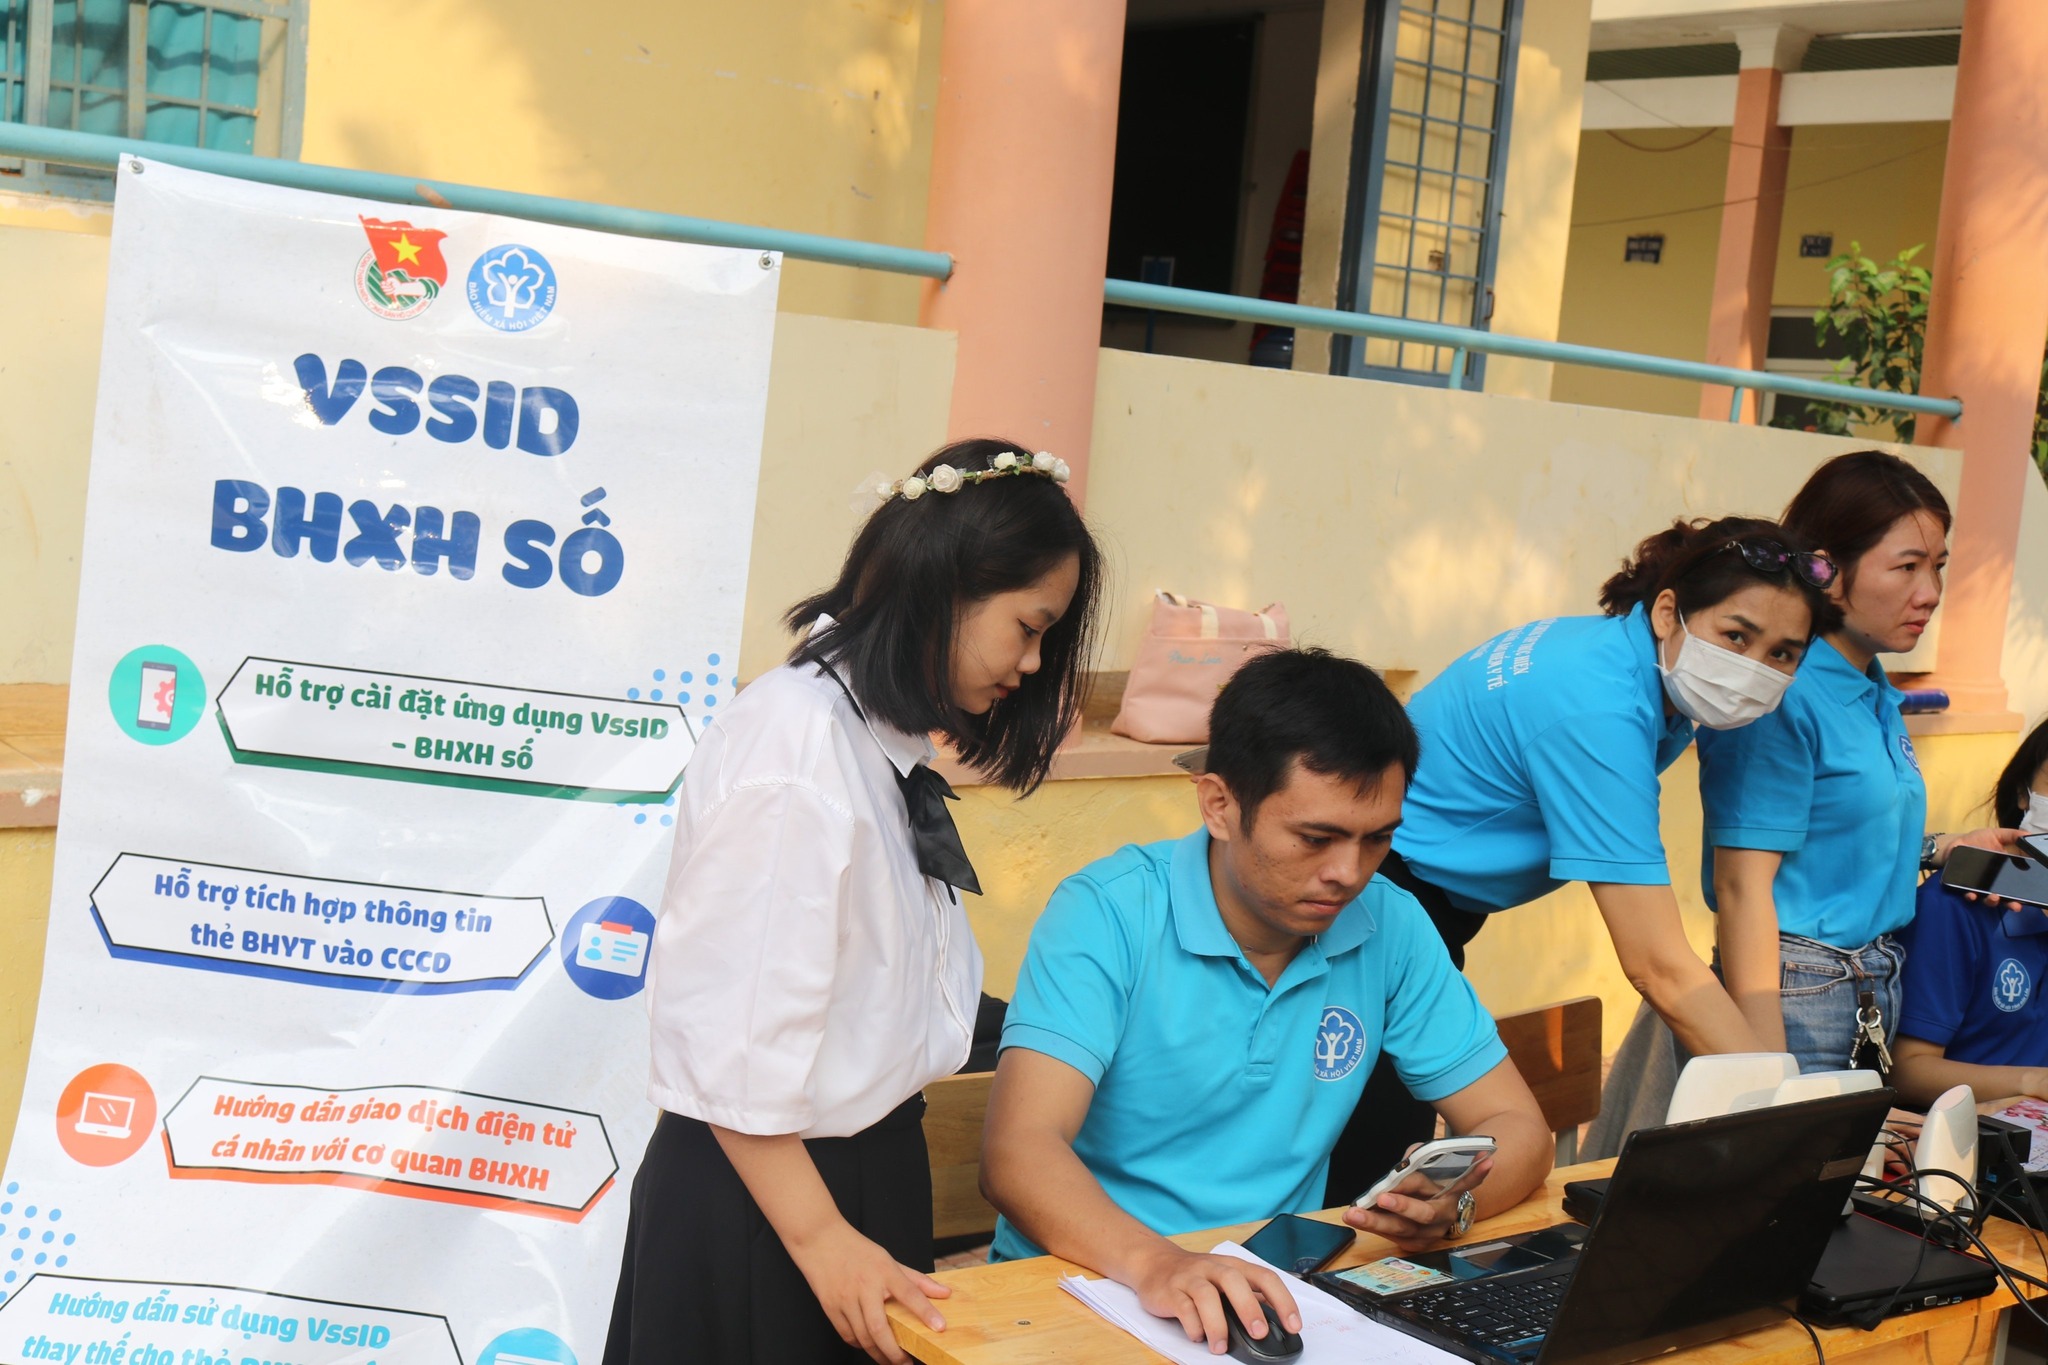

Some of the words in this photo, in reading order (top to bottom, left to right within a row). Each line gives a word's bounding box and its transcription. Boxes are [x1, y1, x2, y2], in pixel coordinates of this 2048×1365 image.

[544, 285, 555, 307] NAM
[293, 352, 580, 457] VSSID
[210, 478, 481, 581] BHXH
[501, 486, 624, 598] SỐ
[255, 666, 294, 698] Hỗ
[300, 679, 344, 710] trợ
[351, 682, 392, 709] cài
[399, 688, 446, 720] đặt
[453, 692, 505, 726] ứng
[512, 702, 583, 735] dụng
[591, 711, 669, 740] VssID
[414, 736, 494, 765] BHXH
[501, 737, 534, 770] số
[154, 867, 192, 898] Hỗ
[197, 880, 239, 911] trợ
[245, 883, 296, 913] tích
[304, 892, 356, 924] hợp
[364, 900, 447, 933] thông
[455, 908, 492, 932] tin
[190, 923, 234, 949] thẻ
[242, 930, 316, 960] BHYT
[323, 939, 373, 967] vào
[381, 947, 452, 973] CCCD
[1354, 1038, 1363, 1056] NAM
[213, 1094, 296, 1124] Hướng
[300, 1094, 346, 1122] dẫn
[346, 1097, 402, 1124] giao
[407, 1099, 469, 1132] dịch
[476, 1111, 536, 1145] điện
[543, 1120, 577, 1148] tử
[211, 1133, 240, 1157] cá
[241, 1138, 306, 1162] nhân
[311, 1137, 350, 1161] với
[352, 1143, 386, 1164] cơ
[390, 1149, 463, 1177] quan
[468, 1157, 550, 1191] BHXH
[48, 1291, 130, 1324] Hướng
[132, 1289, 179, 1322] dẫn
[182, 1297, 220, 1326] sử
[221, 1304, 299, 1343] dụng
[307, 1317, 391, 1349] VssID
[21, 1335, 82, 1365] thay
[85, 1331, 131, 1365] thế
[129, 1343, 174, 1365] cho
